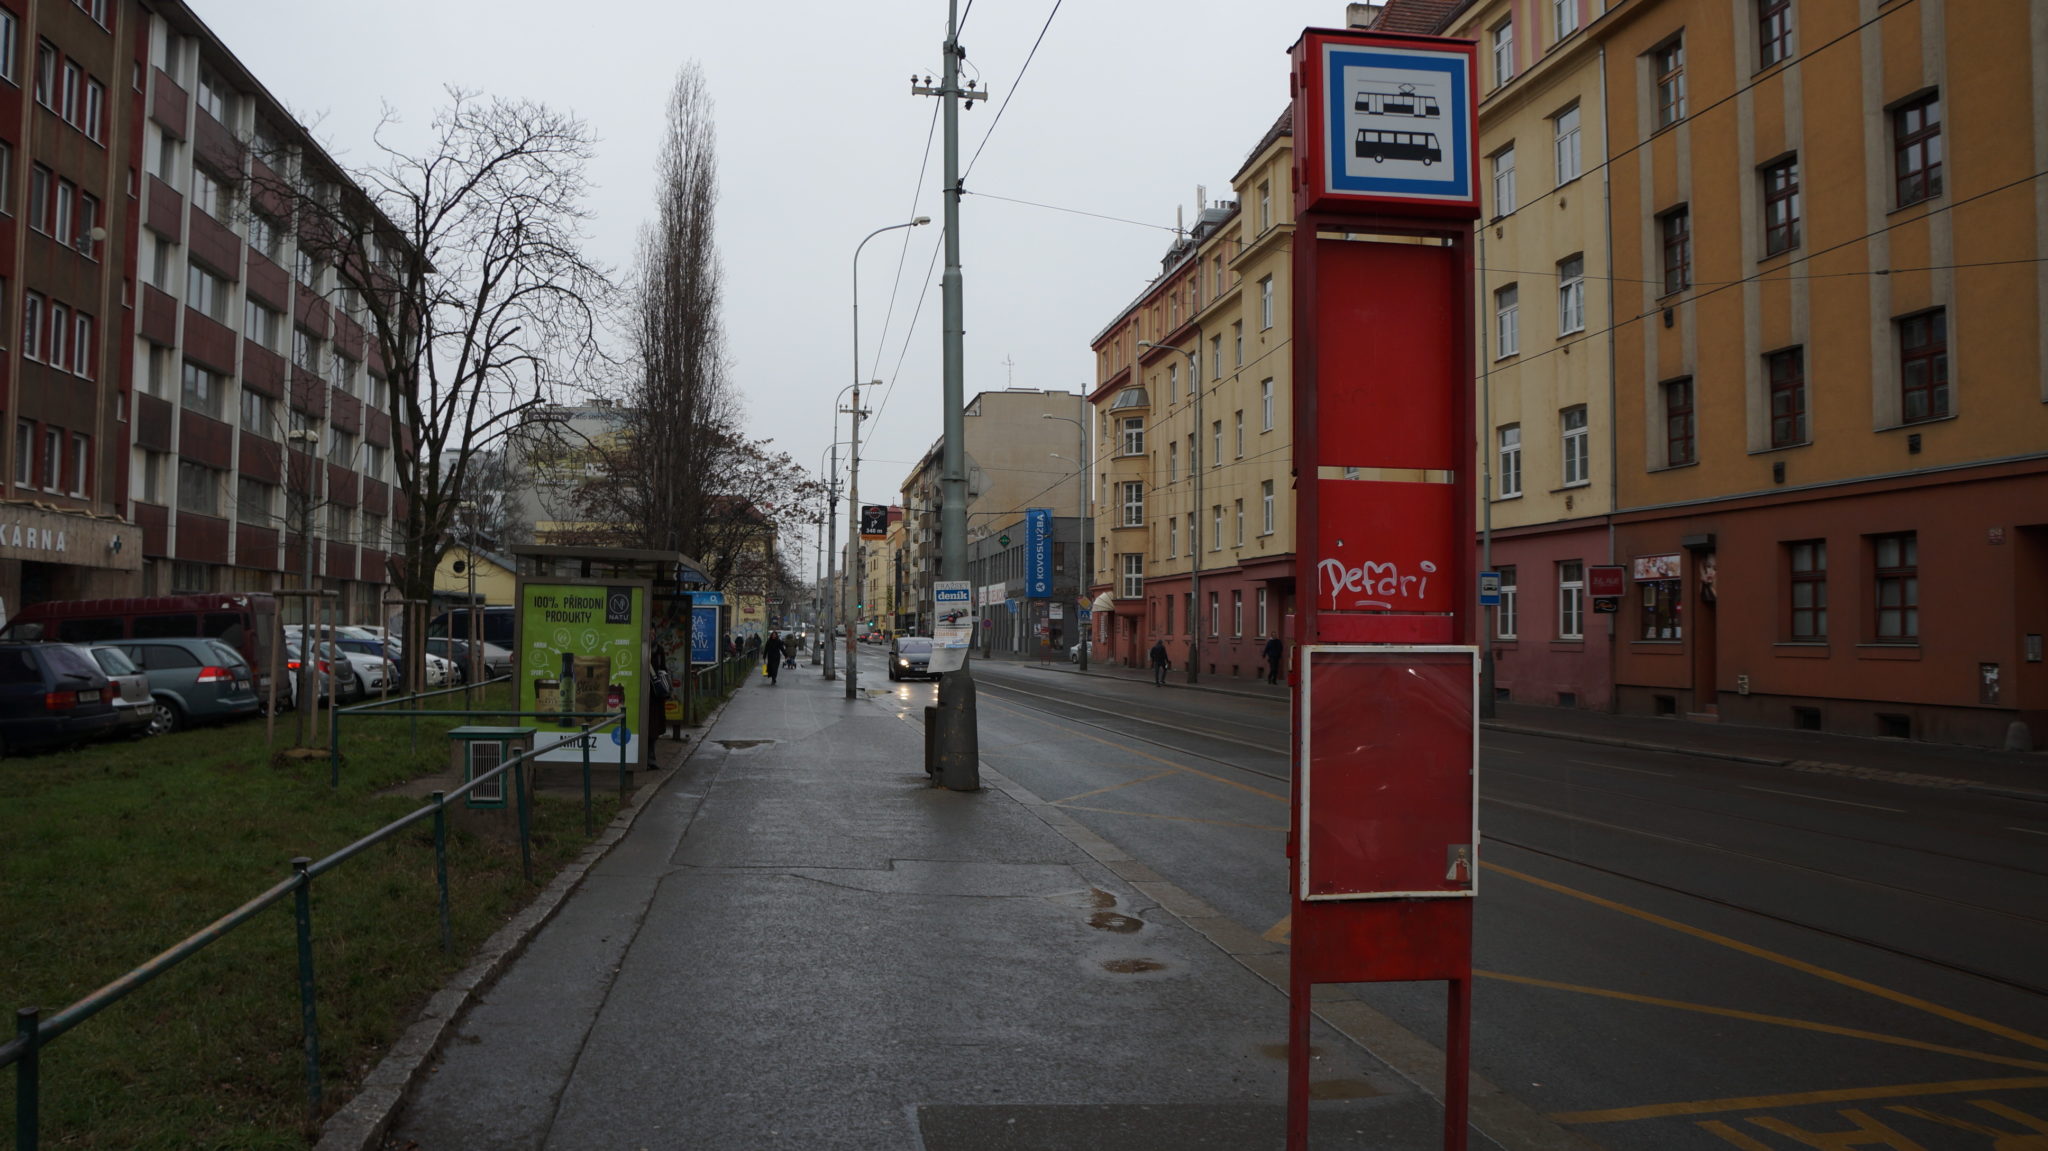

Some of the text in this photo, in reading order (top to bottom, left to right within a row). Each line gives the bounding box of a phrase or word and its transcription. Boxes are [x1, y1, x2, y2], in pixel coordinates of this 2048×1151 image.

[1035, 514, 1045, 579] KOVOSLUŽBA
[534, 594, 604, 609] 100% PŘÍRODNÍ
[545, 610, 592, 623] PRODUKTY
